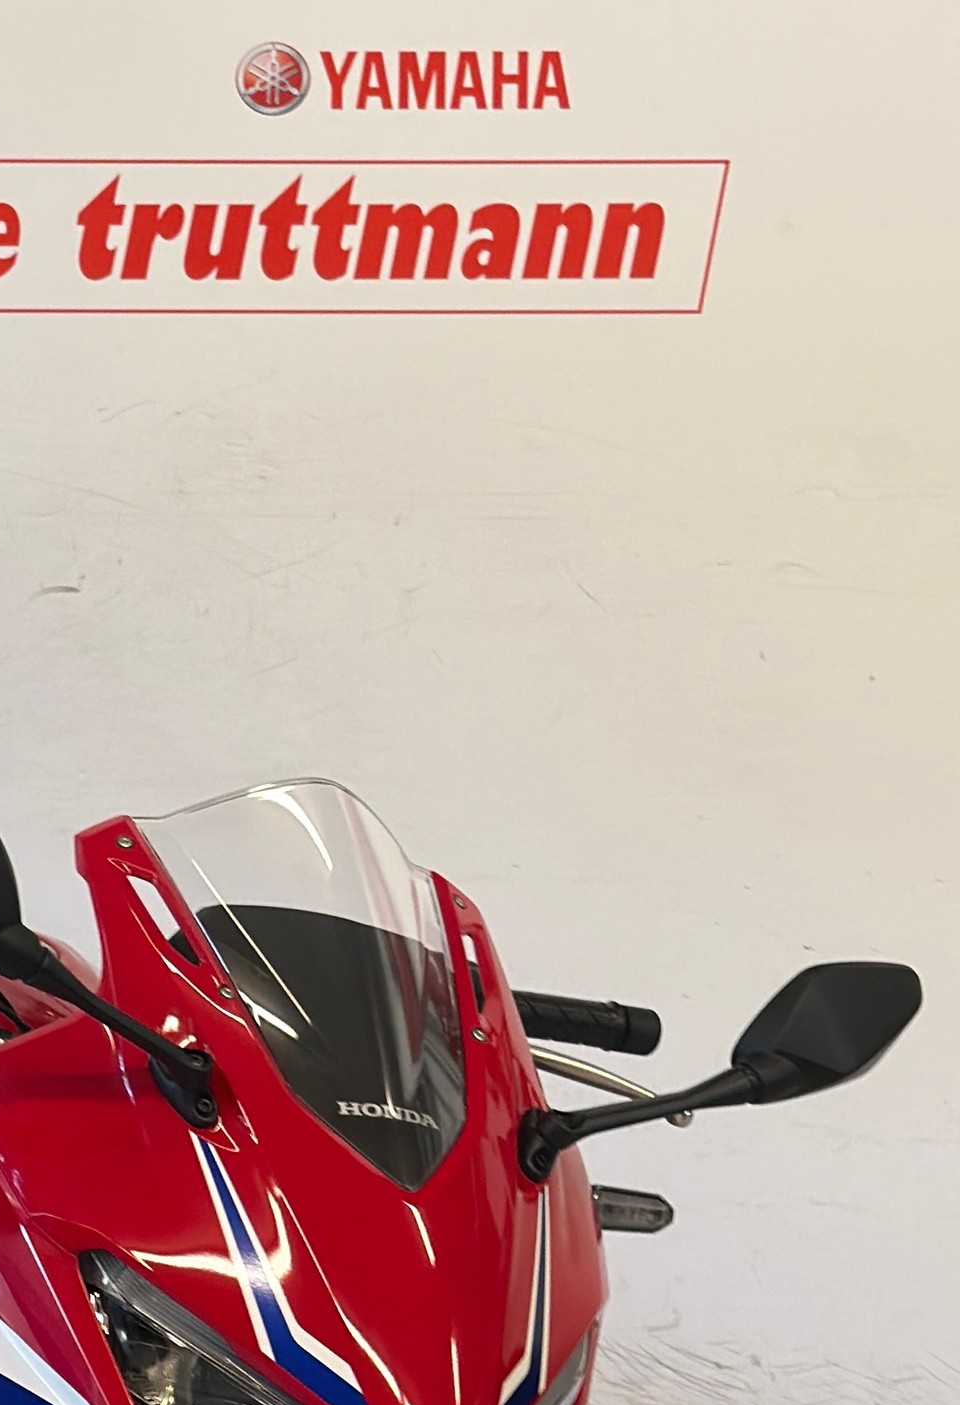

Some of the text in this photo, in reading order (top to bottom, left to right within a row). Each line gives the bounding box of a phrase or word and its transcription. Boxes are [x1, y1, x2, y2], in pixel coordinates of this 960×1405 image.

[319, 50, 571, 111] YAMAHA
[76, 175, 667, 282] truttmann
[336, 1100, 440, 1130] HONDA
